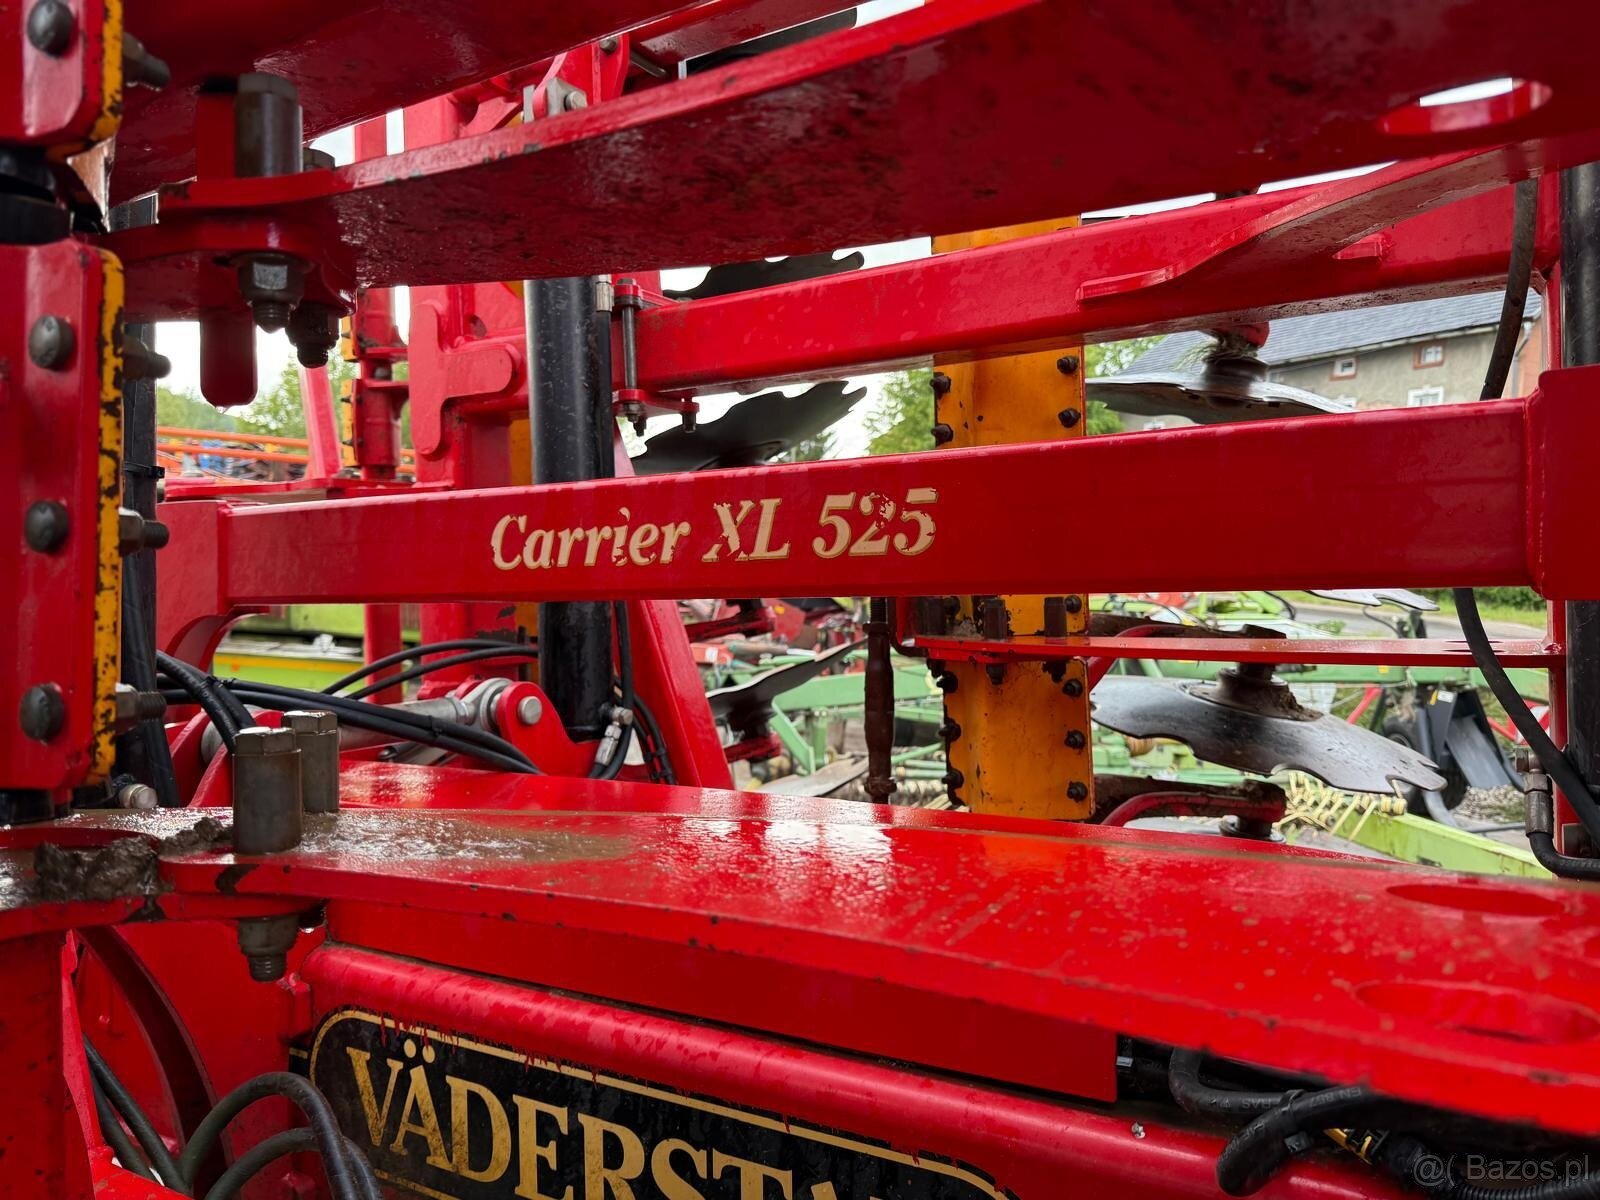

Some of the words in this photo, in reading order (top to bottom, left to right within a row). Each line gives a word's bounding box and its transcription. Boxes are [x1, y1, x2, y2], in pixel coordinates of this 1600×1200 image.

[490, 507, 692, 570] Carrier
[701, 498, 791, 562] XL
[812, 487, 939, 560] 525
